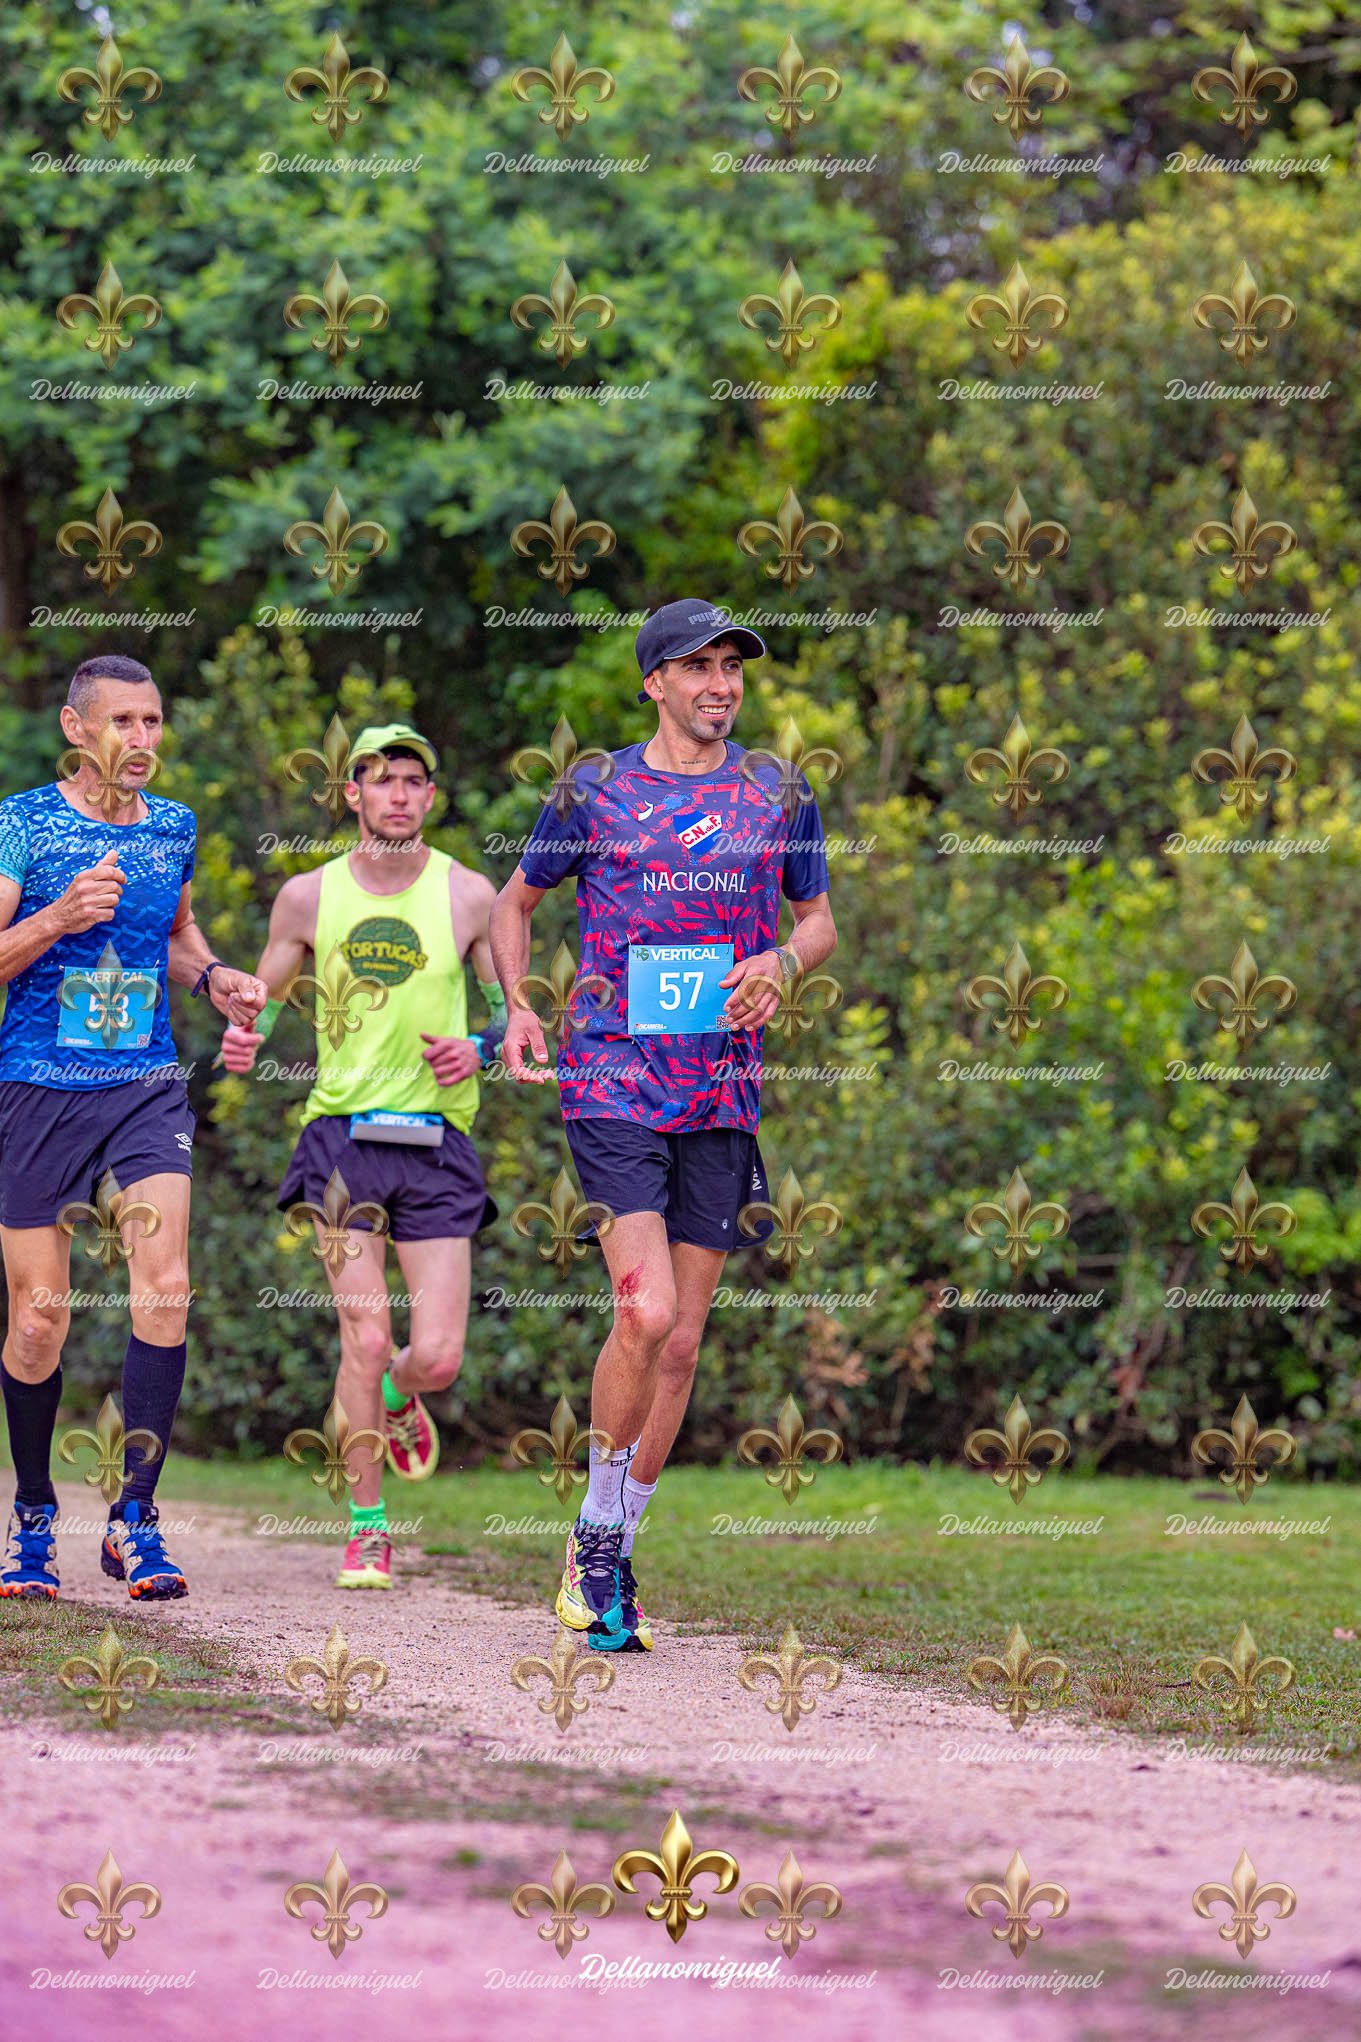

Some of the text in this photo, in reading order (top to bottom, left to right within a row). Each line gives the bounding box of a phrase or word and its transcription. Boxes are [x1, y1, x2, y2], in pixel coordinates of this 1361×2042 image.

[642, 871, 747, 893] NACIONAL
[650, 948, 720, 961] VERTICAL
[84, 971, 145, 984] VERTICAL
[659, 971, 704, 1011] 57
